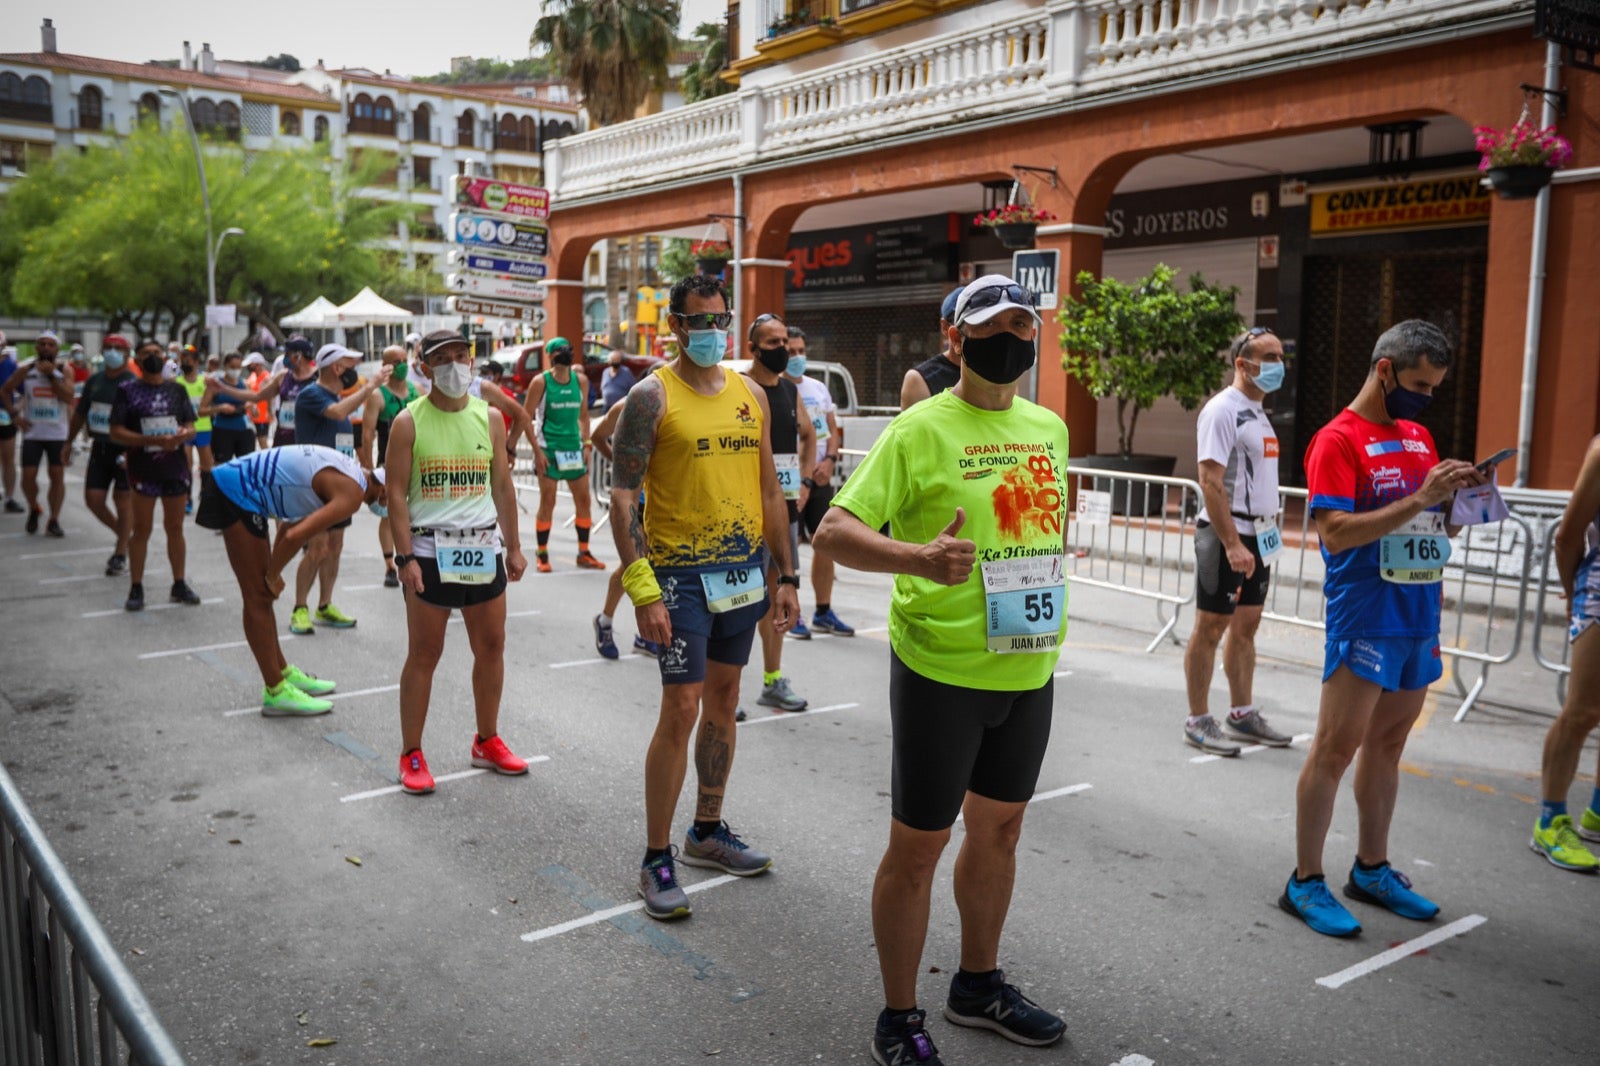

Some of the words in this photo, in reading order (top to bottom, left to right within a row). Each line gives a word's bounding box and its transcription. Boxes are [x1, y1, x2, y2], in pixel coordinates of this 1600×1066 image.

[1132, 206, 1229, 236] JOYEROS
[508, 262, 543, 276] Autovía
[1019, 266, 1051, 293] TAXI
[964, 444, 1000, 456] GRAN
[1004, 443, 1045, 454] PREMIO
[959, 459, 975, 469] DE
[979, 456, 1018, 467] FONDO
[1028, 455, 1061, 535] 2018
[1404, 538, 1441, 560] 166
[452, 550, 484, 567] 202
[1409, 570, 1434, 581] ANDRÉS
[731, 594, 750, 607] JAVIER
[1025, 592, 1054, 623] 55
[1010, 637, 1033, 650] JUAN
